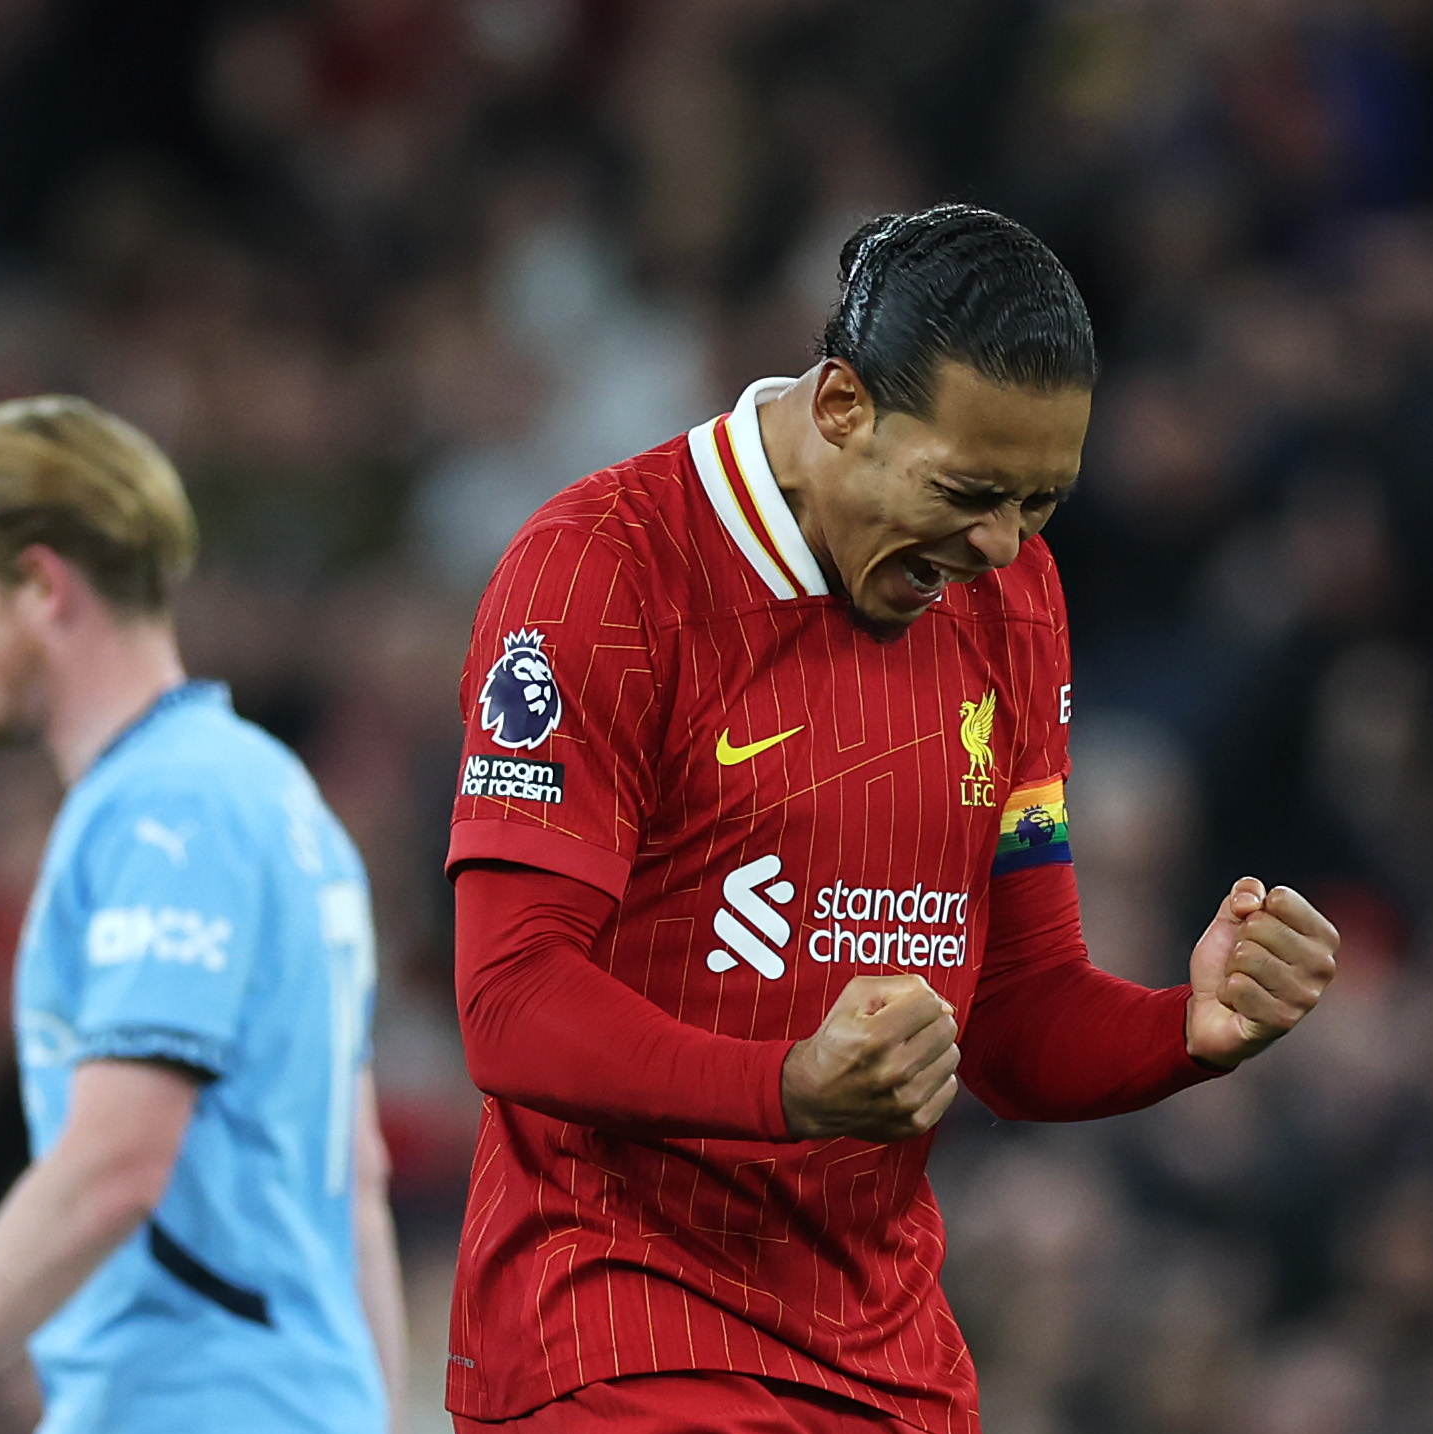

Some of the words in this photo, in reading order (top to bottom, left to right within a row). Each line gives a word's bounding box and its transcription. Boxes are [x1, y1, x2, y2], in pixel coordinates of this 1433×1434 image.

[464, 755, 489, 777] No
[491, 760, 554, 784] room
[488, 778, 562, 804] racism
[960, 782, 996, 807] L.F.C.
[813, 879, 968, 925] standard
[808, 922, 967, 967] chartered
